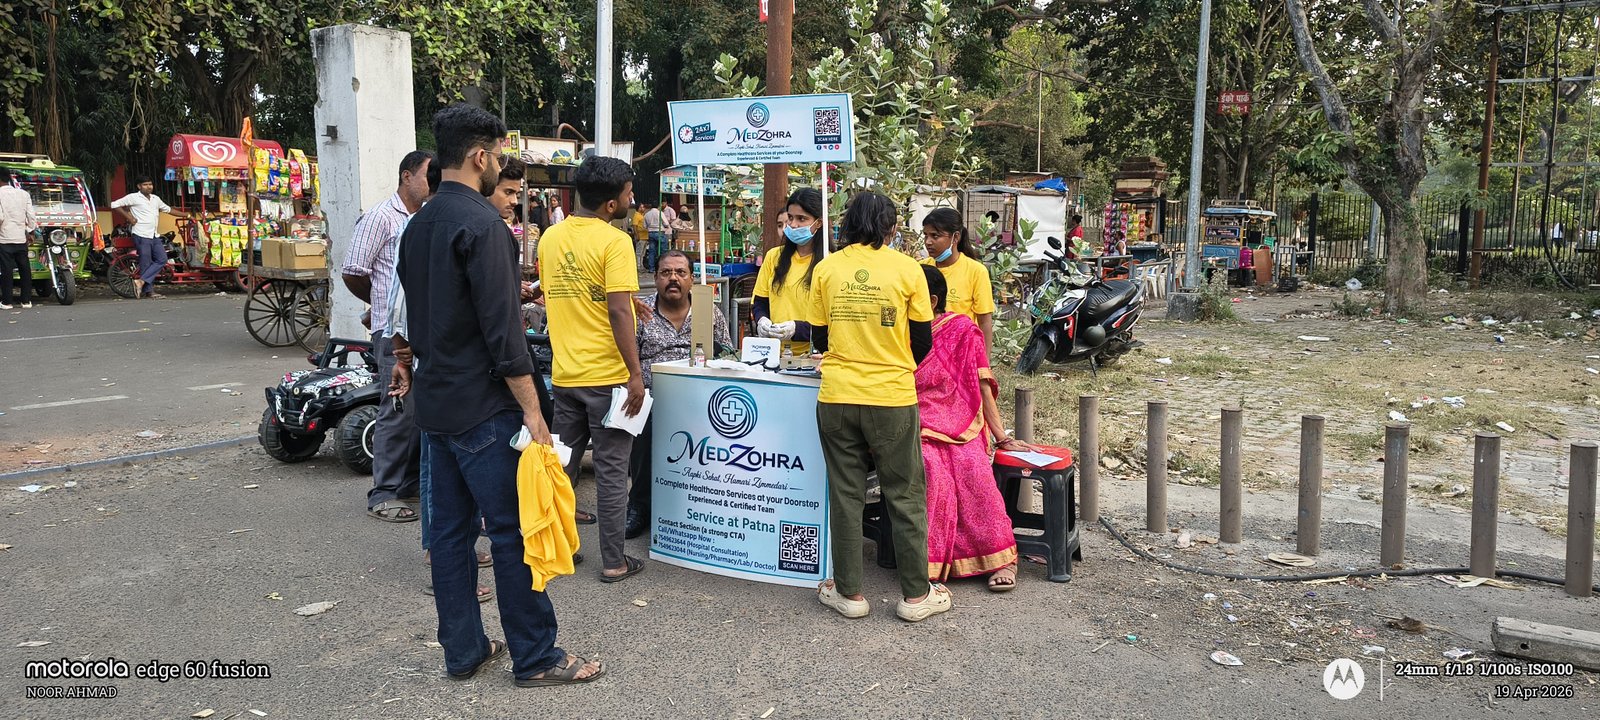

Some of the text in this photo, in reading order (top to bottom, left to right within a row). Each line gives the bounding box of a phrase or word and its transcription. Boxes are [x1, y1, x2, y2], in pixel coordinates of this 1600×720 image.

[682, 467, 701, 480] Aapki
[723, 473, 750, 486] Hamari
[752, 477, 788, 490] Zimmedari
[660, 478, 688, 490] Complete
[690, 484, 725, 496] Healthcare
[726, 490, 756, 500] Services
[766, 496, 783, 504] your
[784, 497, 819, 510] Doorstep
[688, 494, 722, 506] Experienced
[730, 501, 756, 511] Certified
[758, 505, 774, 513] Team
[658, 517, 745, 541] Contact Section (a strong CTA)
[687, 508, 775, 533] Service at Patna
[658, 525, 697, 540] Call/Whatsapp
[698, 534, 711, 542] Now
[687, 541, 710, 551] (Hospital
[711, 546, 748, 559] Consultation)
[754, 561, 776, 572] Doctor)
